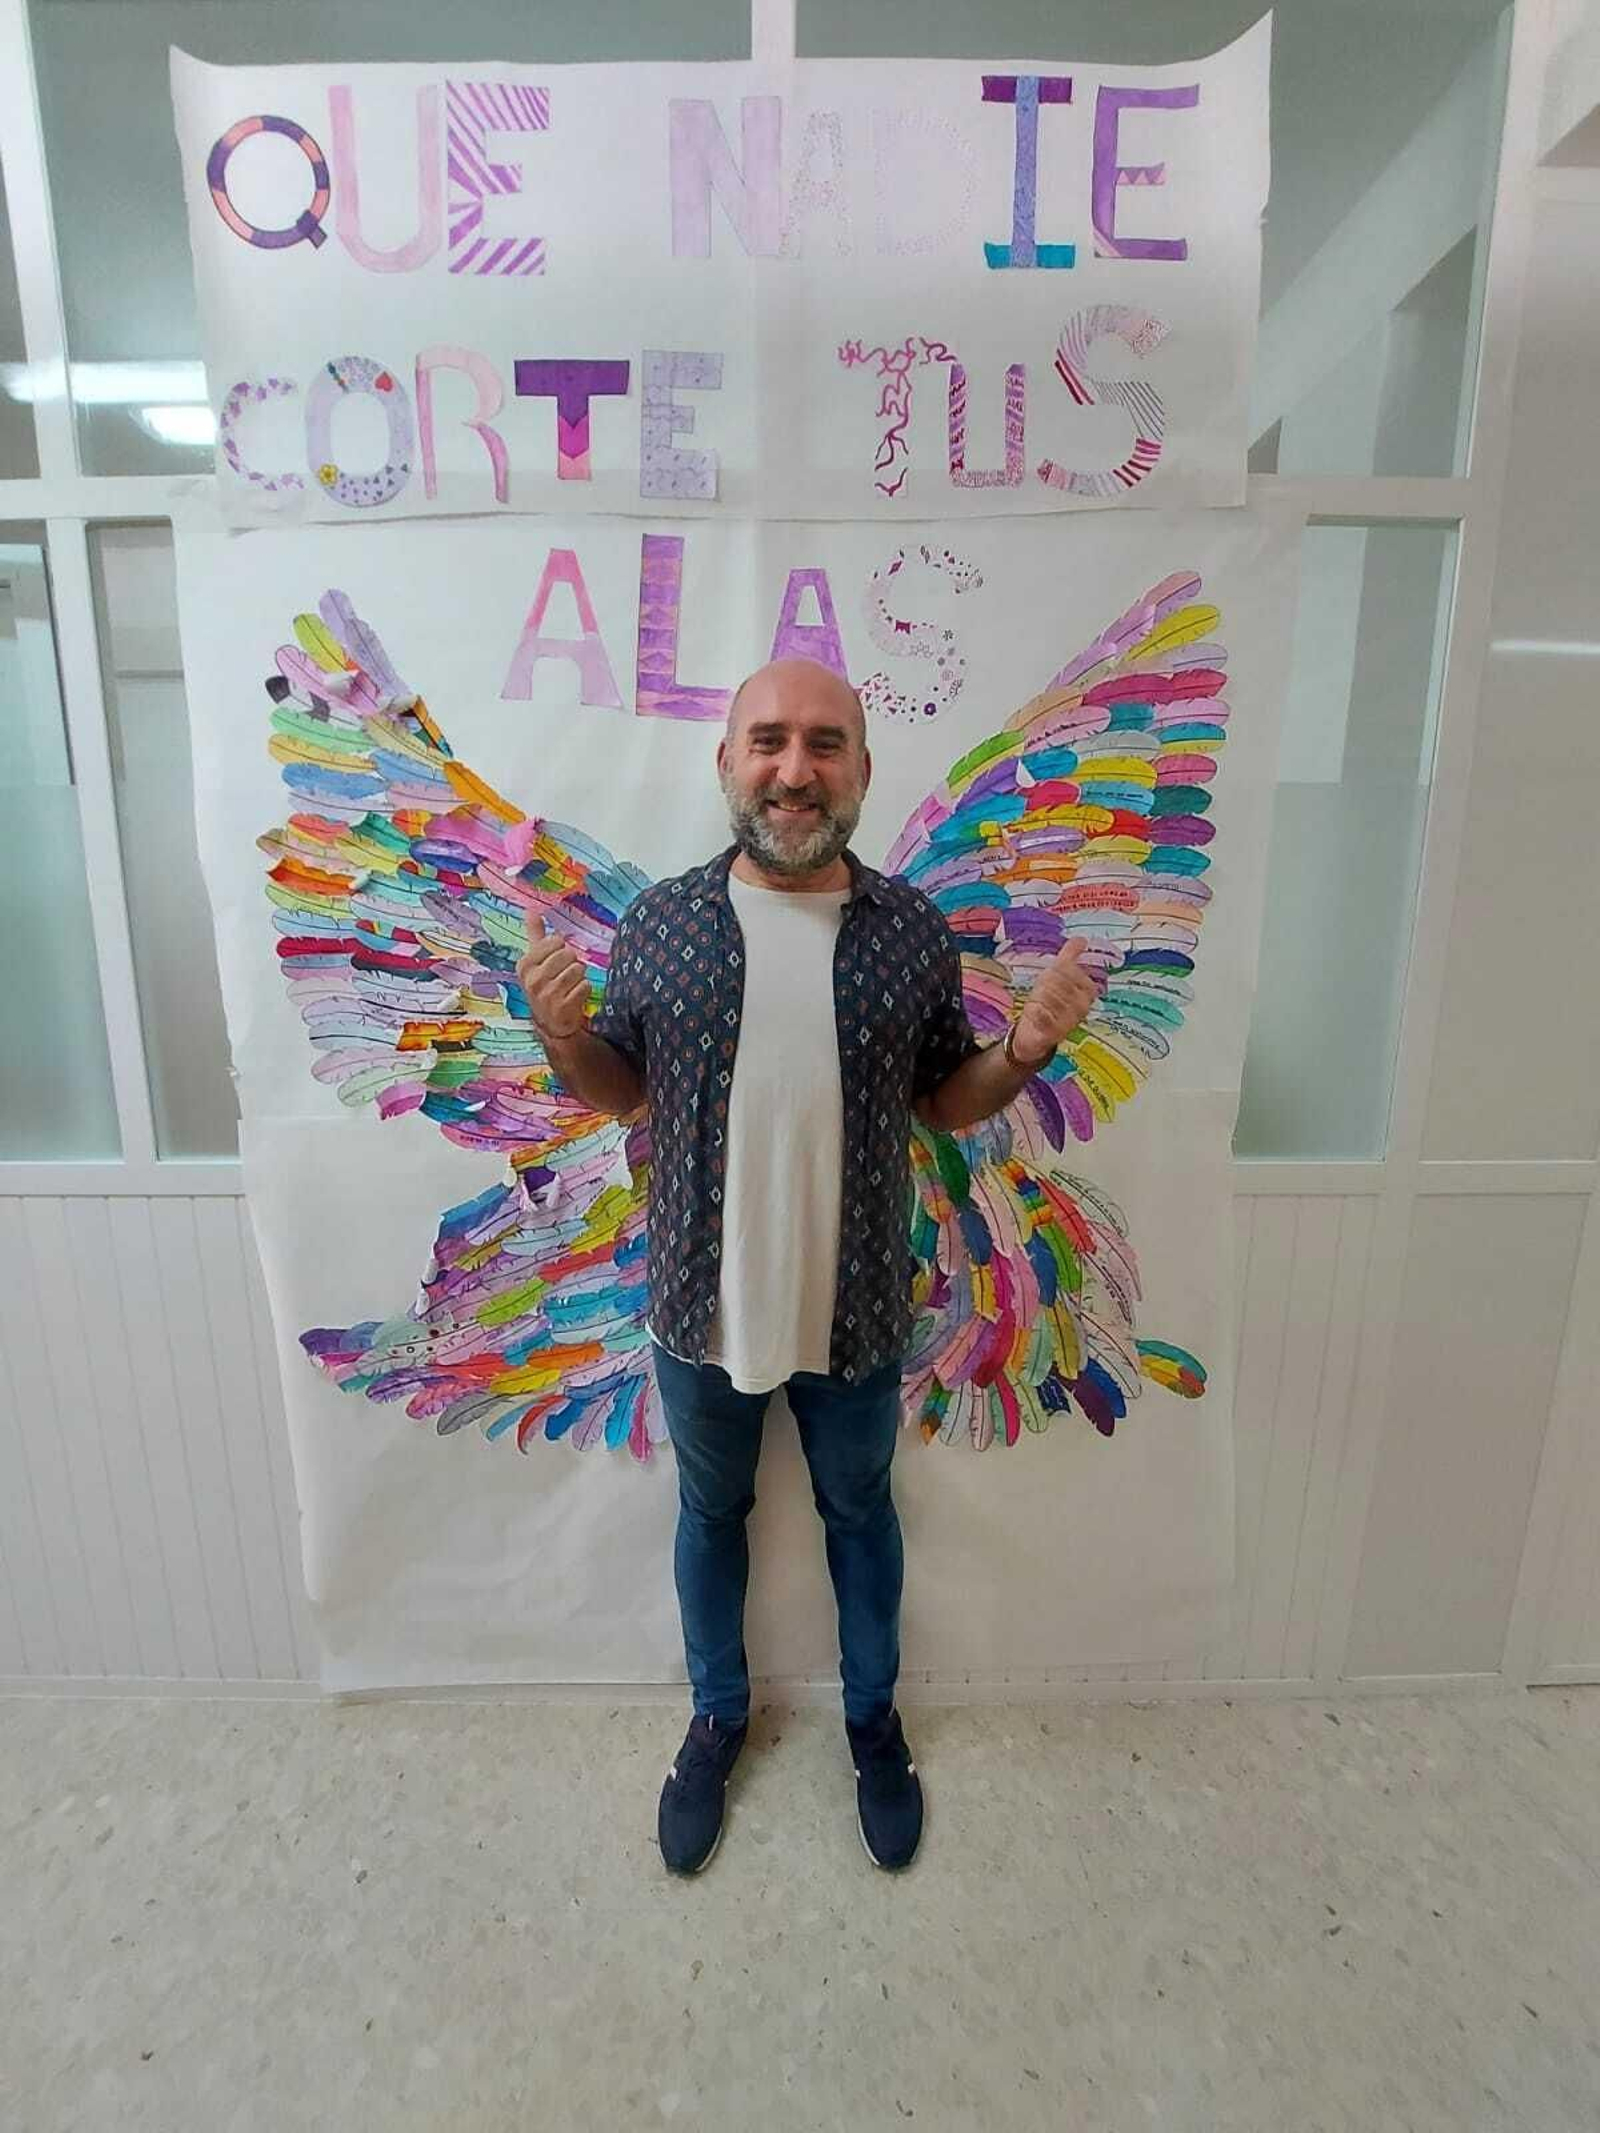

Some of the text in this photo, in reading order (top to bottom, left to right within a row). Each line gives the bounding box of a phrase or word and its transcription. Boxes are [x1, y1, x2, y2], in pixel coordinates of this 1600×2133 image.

[206, 75, 1200, 276] QUE NADIE
[219, 304, 1172, 508] CORTE TUS
[500, 533, 984, 725] ALAS
